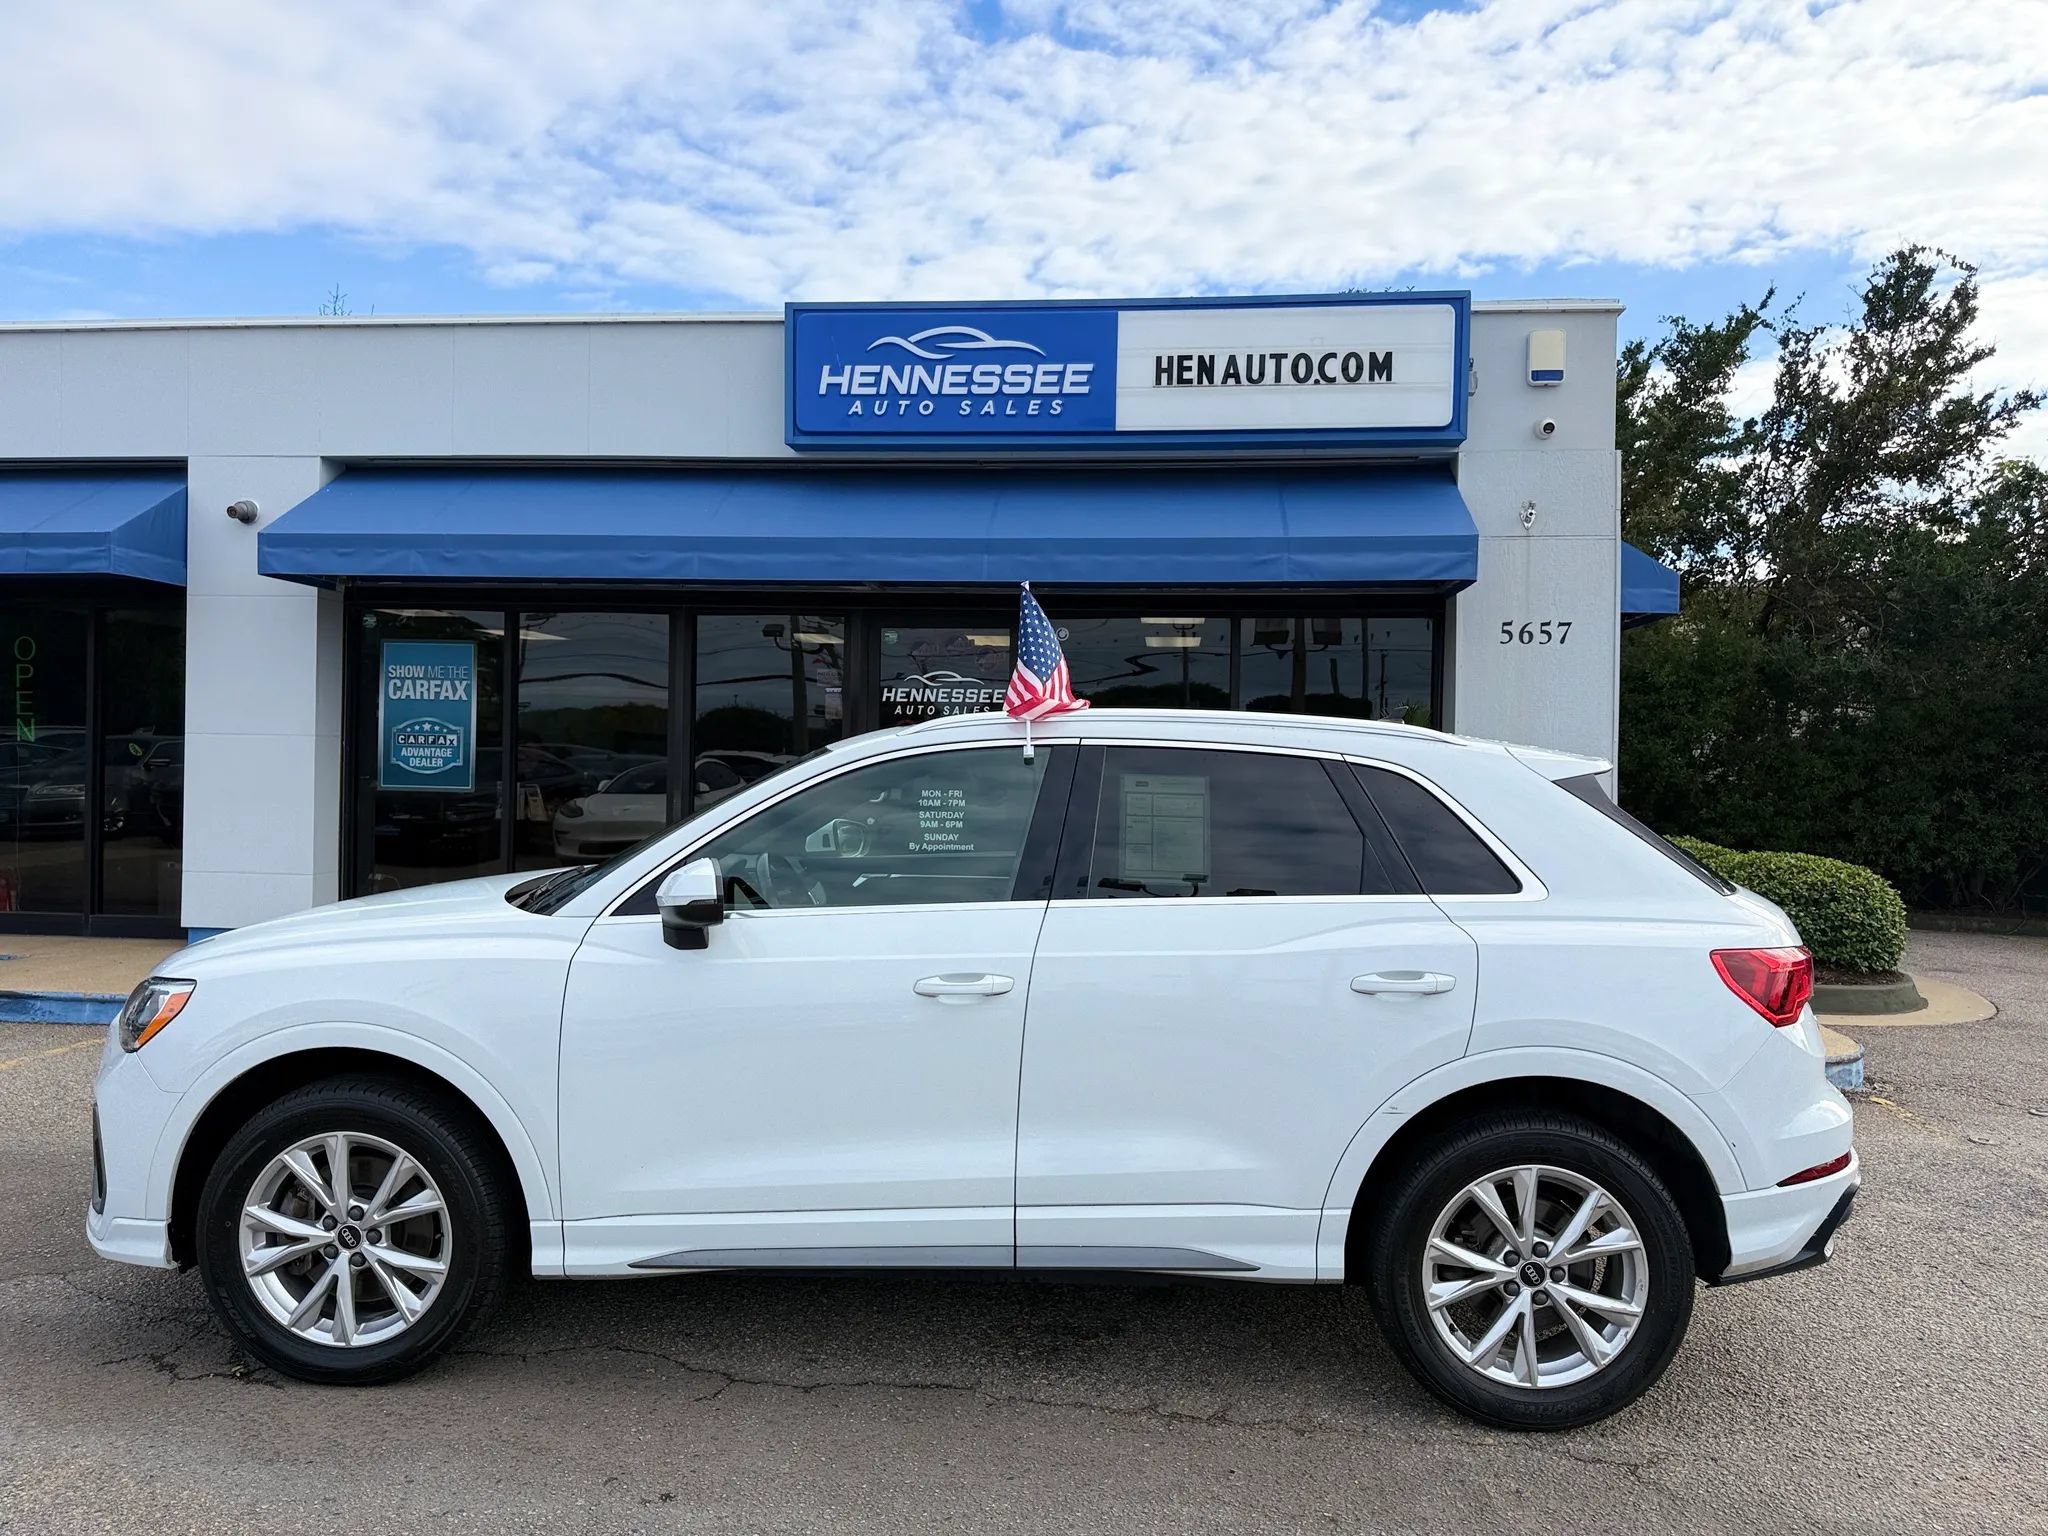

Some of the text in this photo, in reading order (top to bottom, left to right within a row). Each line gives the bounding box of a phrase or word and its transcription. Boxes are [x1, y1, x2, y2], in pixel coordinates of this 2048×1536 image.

[1155, 351, 1393, 385] HENAUTO.COM
[818, 363, 1094, 395] HENNESSEE
[848, 400, 1063, 415] AUTO SALES
[1500, 620, 1572, 644] 5657
[388, 665, 468, 679] SHOW ME THE
[14, 636, 36, 742] OPEN
[388, 680, 468, 700] CARFAX
[882, 688, 1006, 703] HENNESSEE
[894, 705, 936, 715] AUTO
[397, 734, 457, 746] CARFAX
[401, 747, 452, 757] ADVANTAGE
[410, 757, 443, 766] DEALER
[921, 790, 941, 798] MON
[948, 790, 963, 798] FRI
[918, 799, 941, 807] 10AM
[948, 799, 966, 807] 7PM
[919, 811, 965, 819] SATURDAY
[924, 833, 959, 841] SUNDAY
[909, 843, 975, 851] By Appointment
